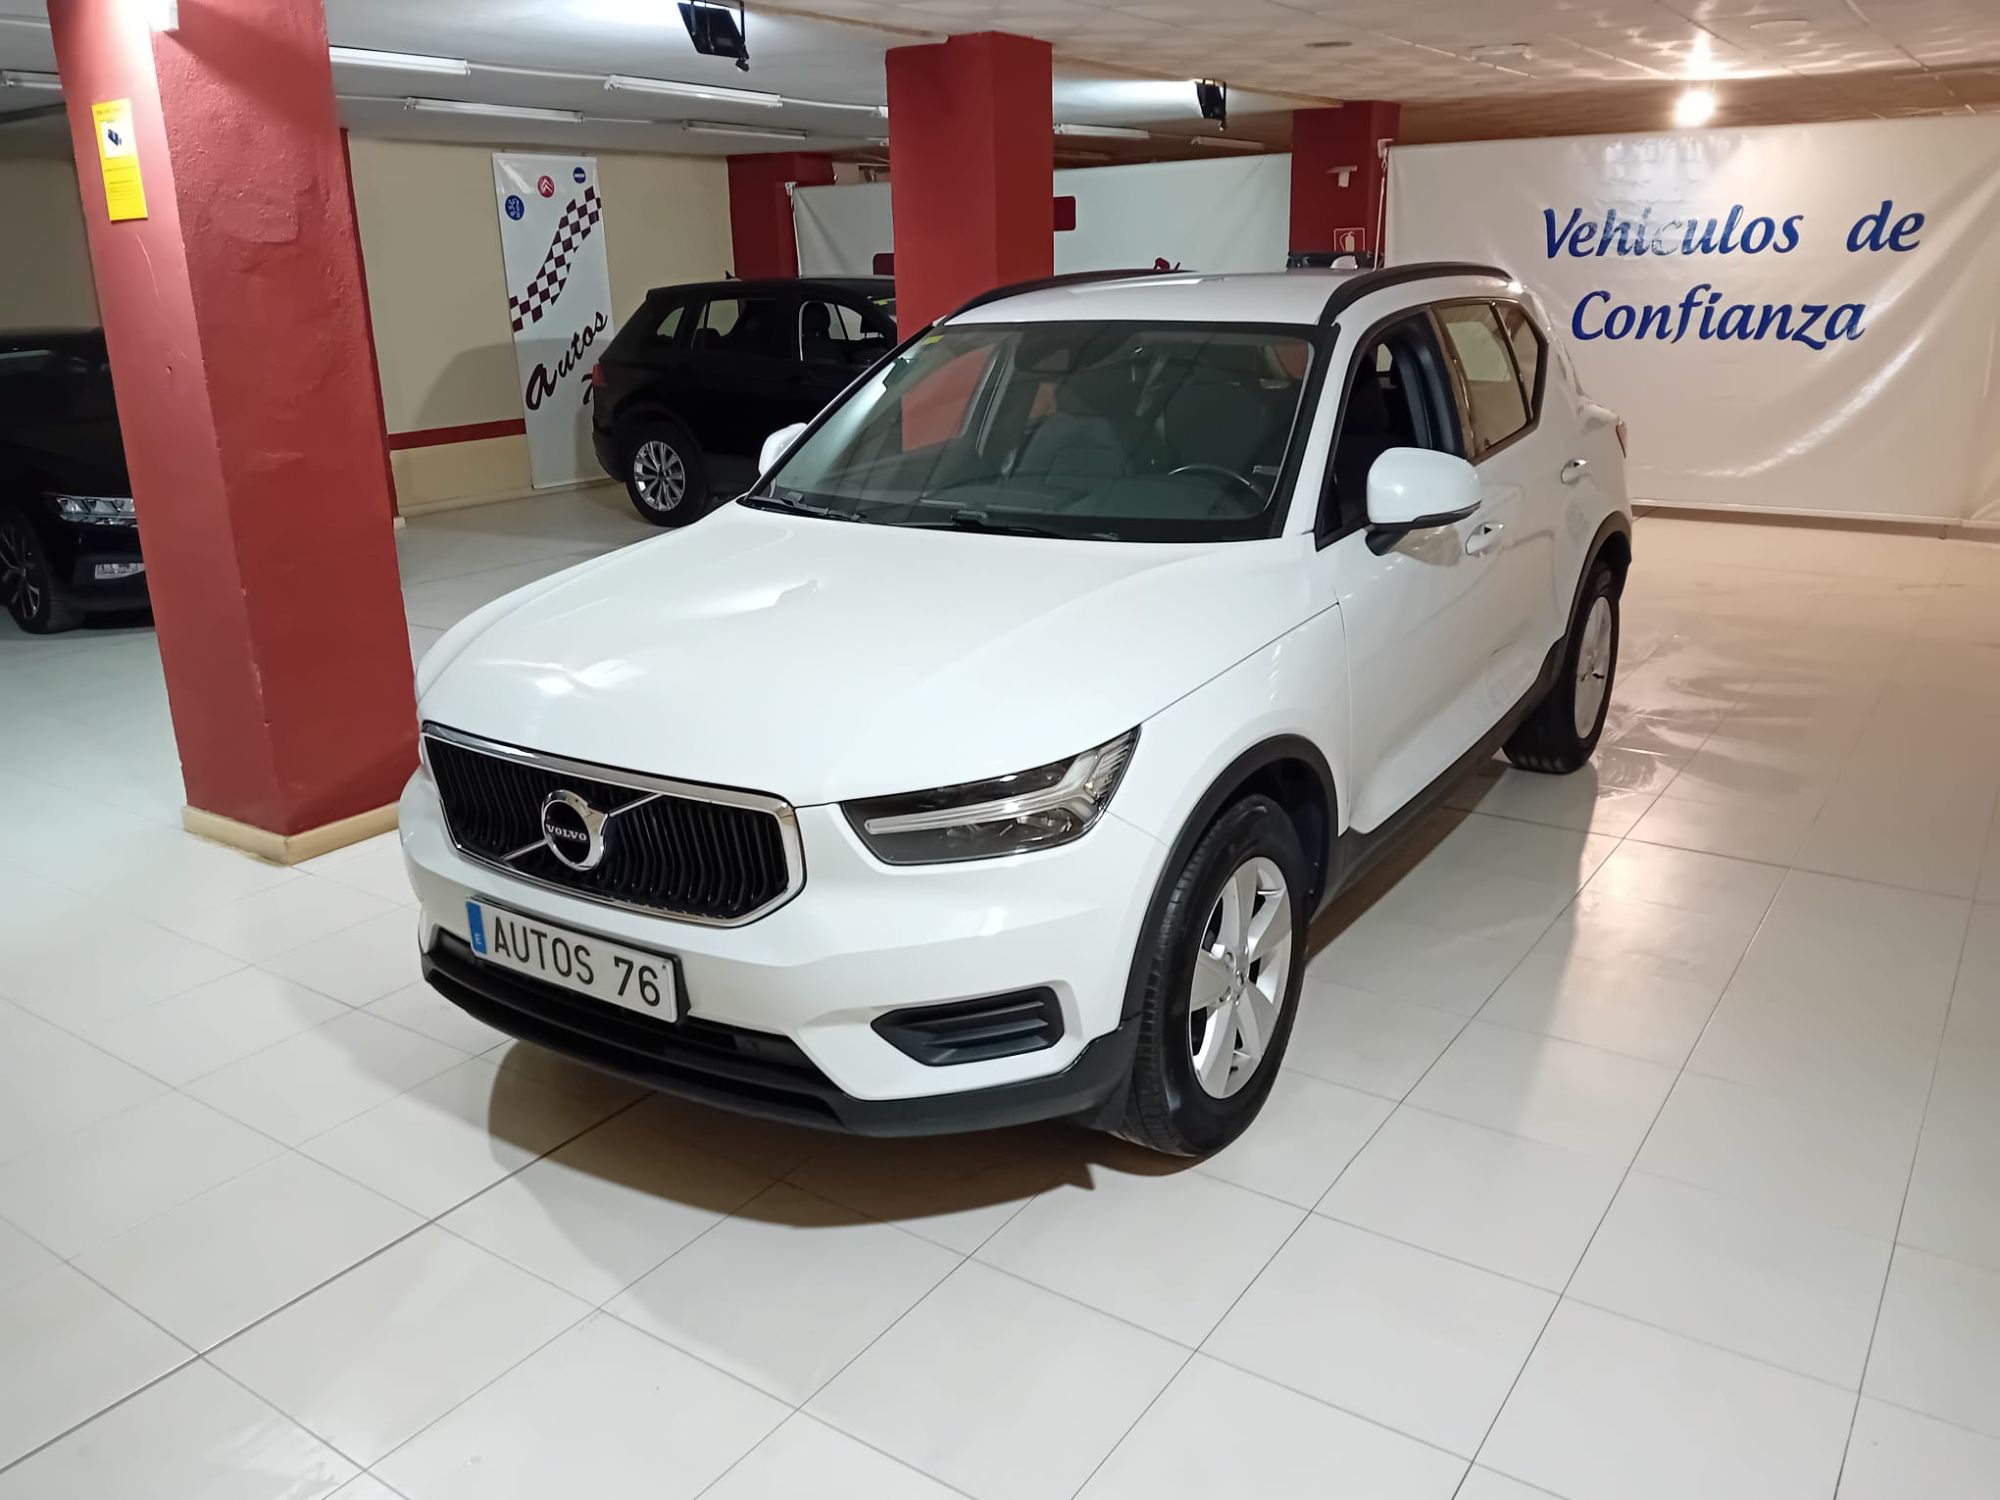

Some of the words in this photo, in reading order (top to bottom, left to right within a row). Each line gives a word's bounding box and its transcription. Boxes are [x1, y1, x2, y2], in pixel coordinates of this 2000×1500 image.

[1846, 200, 1926, 252] de
[1571, 283, 1867, 350] Confianza
[525, 311, 608, 410] Autos
[545, 823, 588, 842] VOLVO
[494, 916, 594, 985] AUTOS
[613, 955, 661, 1007] 76
